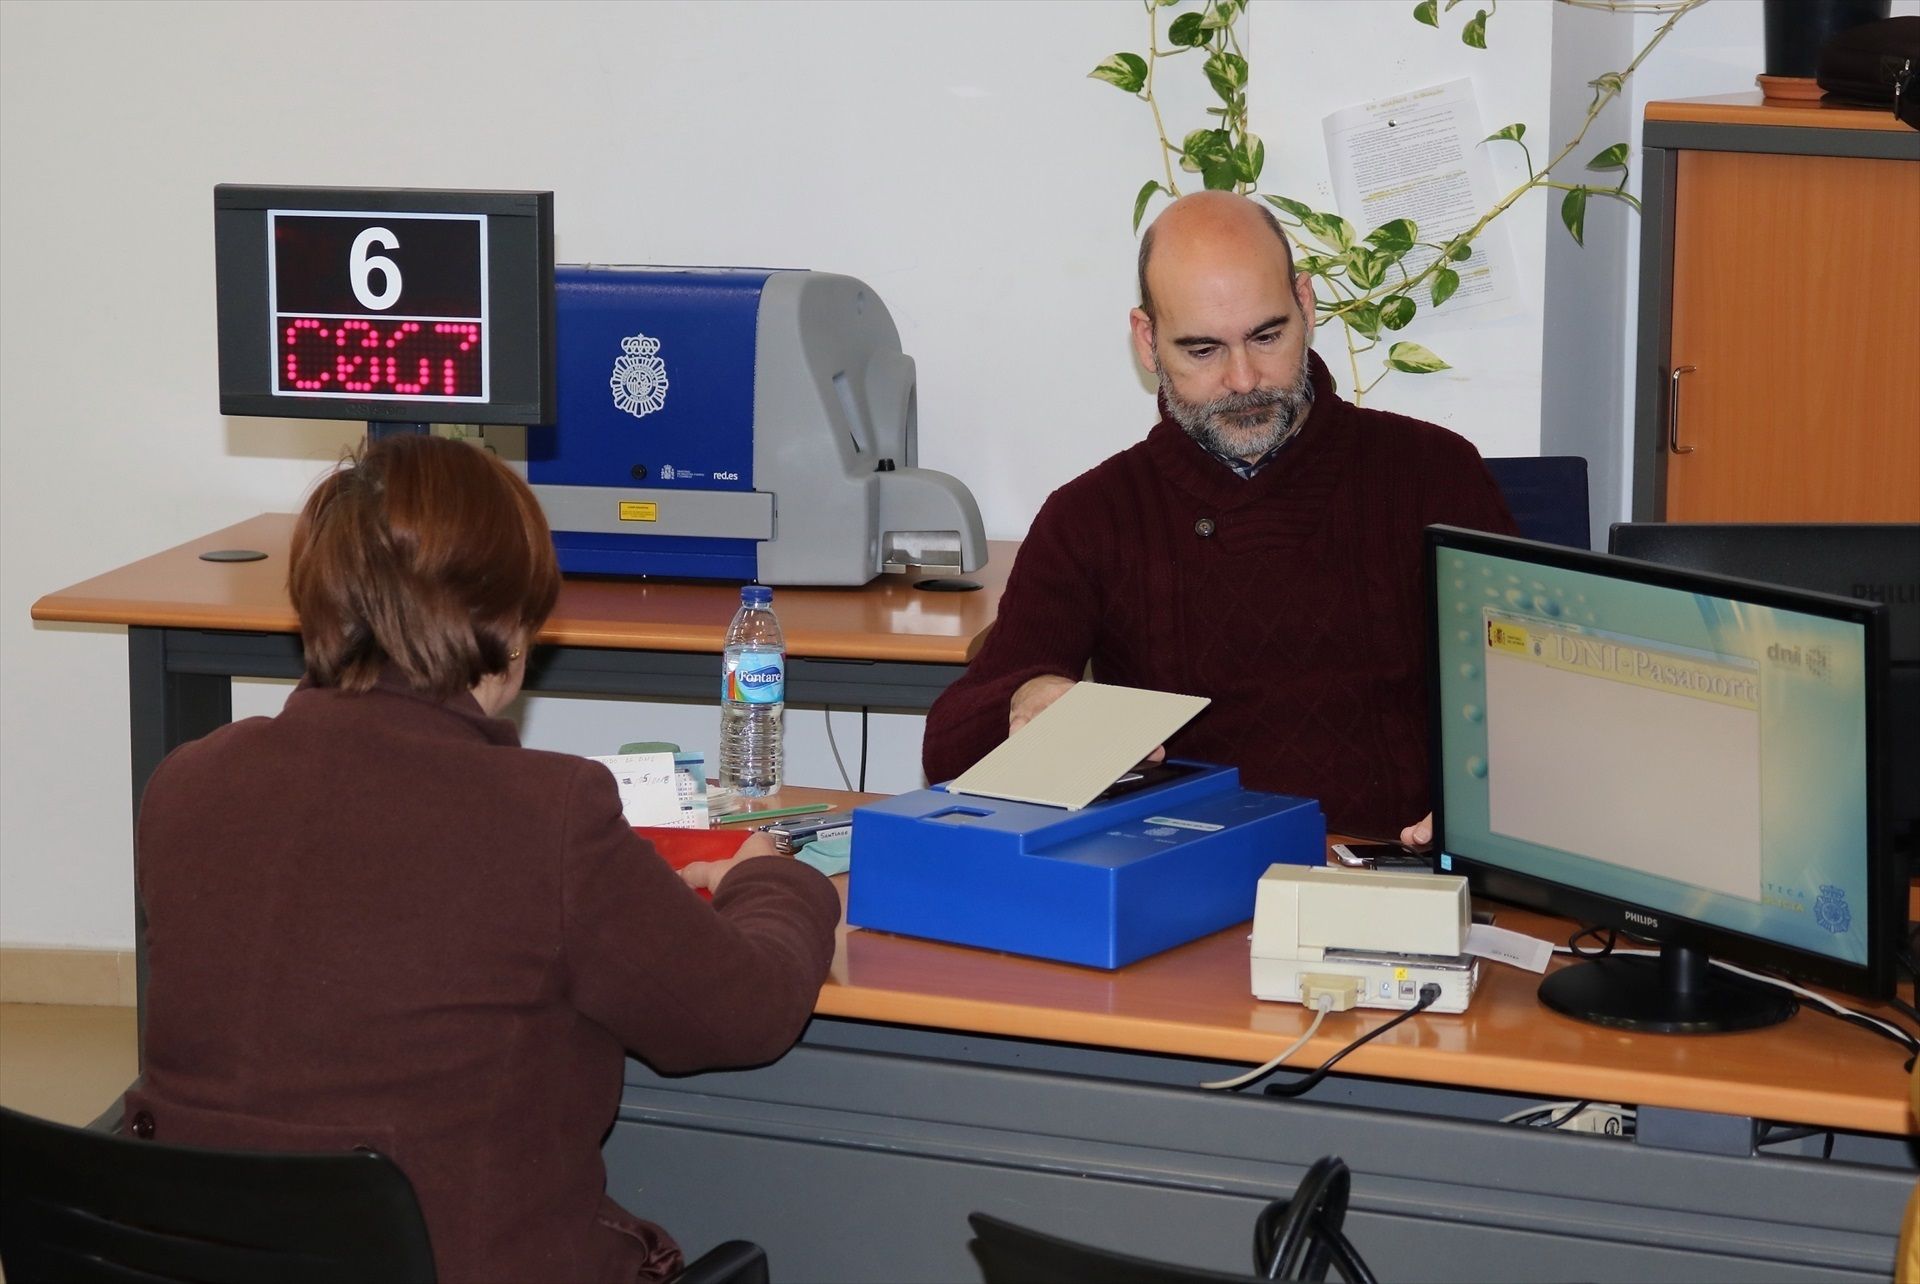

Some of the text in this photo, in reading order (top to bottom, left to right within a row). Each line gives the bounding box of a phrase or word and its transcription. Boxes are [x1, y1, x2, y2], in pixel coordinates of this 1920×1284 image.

[350, 226, 402, 310] 6
[713, 471, 738, 480] red.es
[1851, 583, 1920, 604] PHILI
[1624, 911, 1659, 928] PHILIPS
